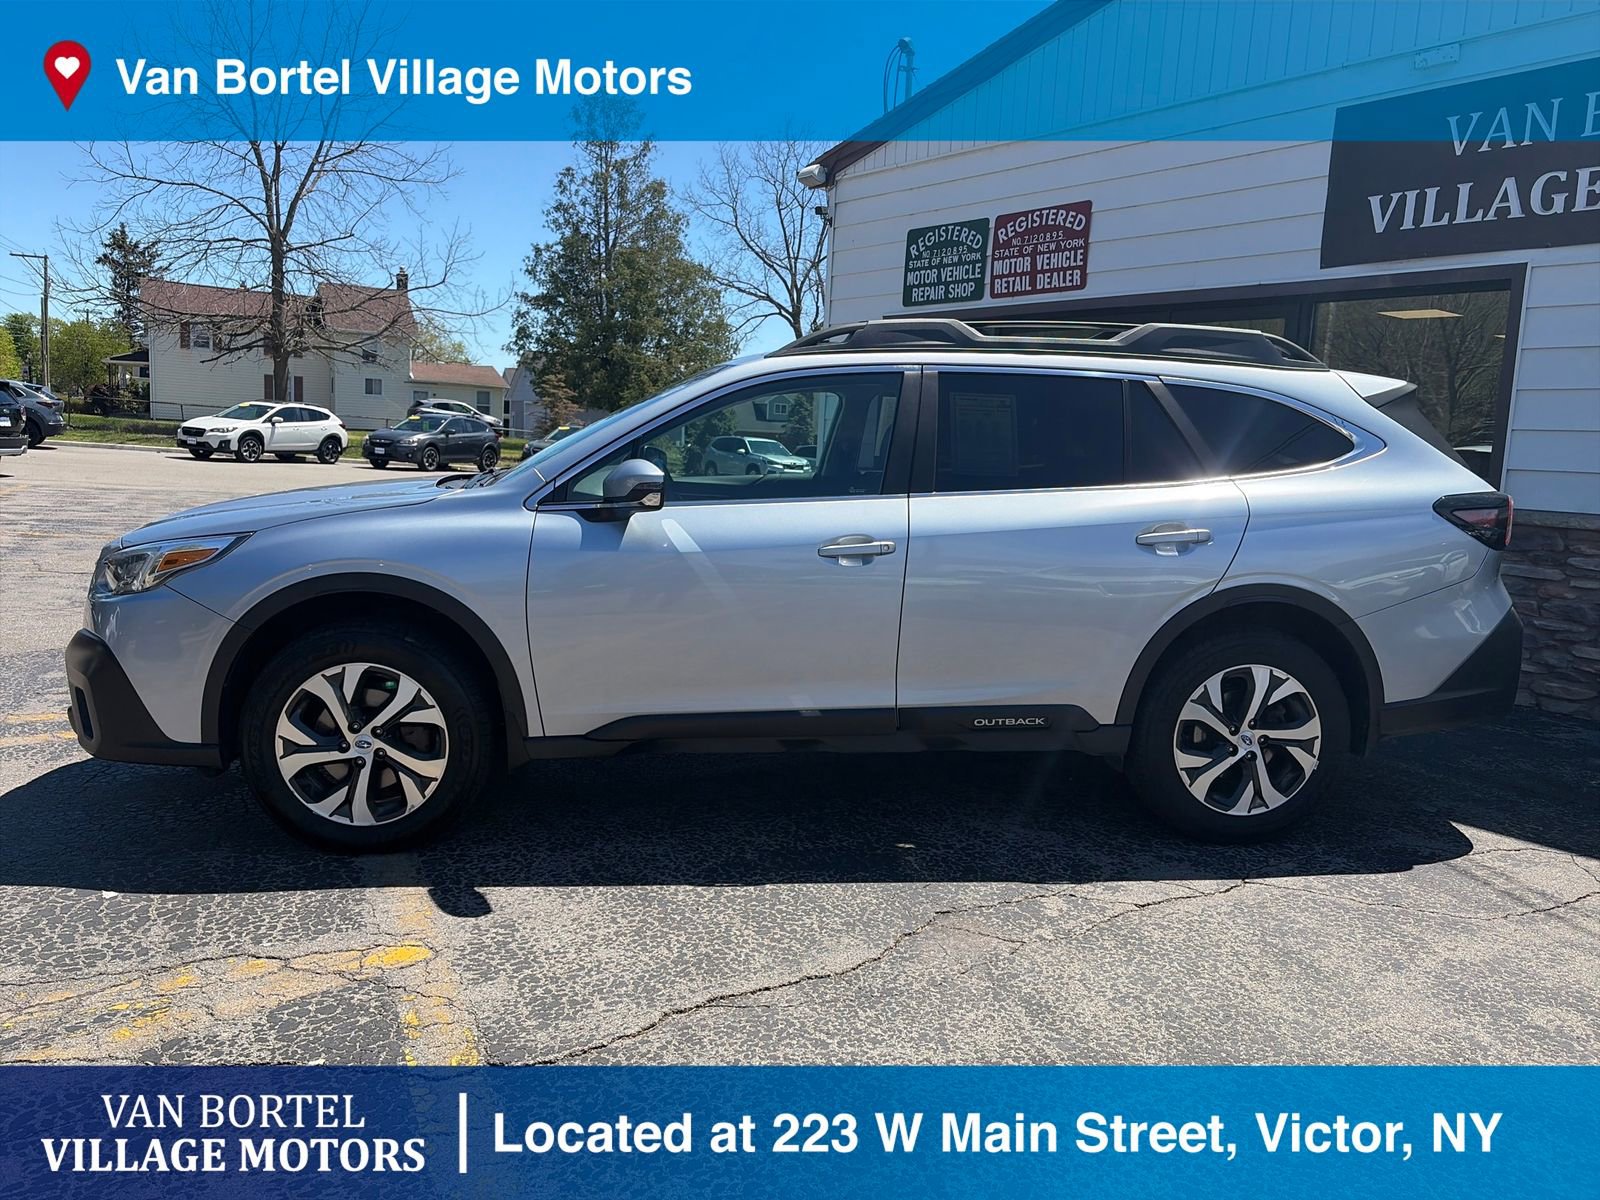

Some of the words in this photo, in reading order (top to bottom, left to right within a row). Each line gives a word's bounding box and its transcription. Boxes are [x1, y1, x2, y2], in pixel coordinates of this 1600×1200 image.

[1446, 97, 1564, 156] VAN
[1367, 166, 1600, 234] VILLAGE
[997, 209, 1086, 244] REGISTERED
[1024, 230, 1064, 244] 7120895
[909, 225, 983, 259] REGISTERED
[933, 245, 968, 257] 7120895
[994, 247, 1019, 258] STATE
[1022, 245, 1034, 255] OF
[1037, 242, 1056, 253] NEW
[1060, 238, 1085, 249] YORK
[908, 257, 929, 269] STATE
[931, 258, 941, 266] OF
[943, 255, 958, 265] NEW
[961, 252, 982, 262] YORK
[993, 256, 1031, 276] MOTOR
[1036, 249, 1084, 271] VEHICLE
[906, 269, 938, 286] MOTOR
[940, 263, 982, 282] VEHICLE
[994, 275, 1032, 294] RETAIL
[1036, 269, 1081, 290] DEALER
[912, 285, 945, 302] REPAIR
[948, 282, 975, 299] SHOP
[974, 717, 1046, 726] OUTBACK
